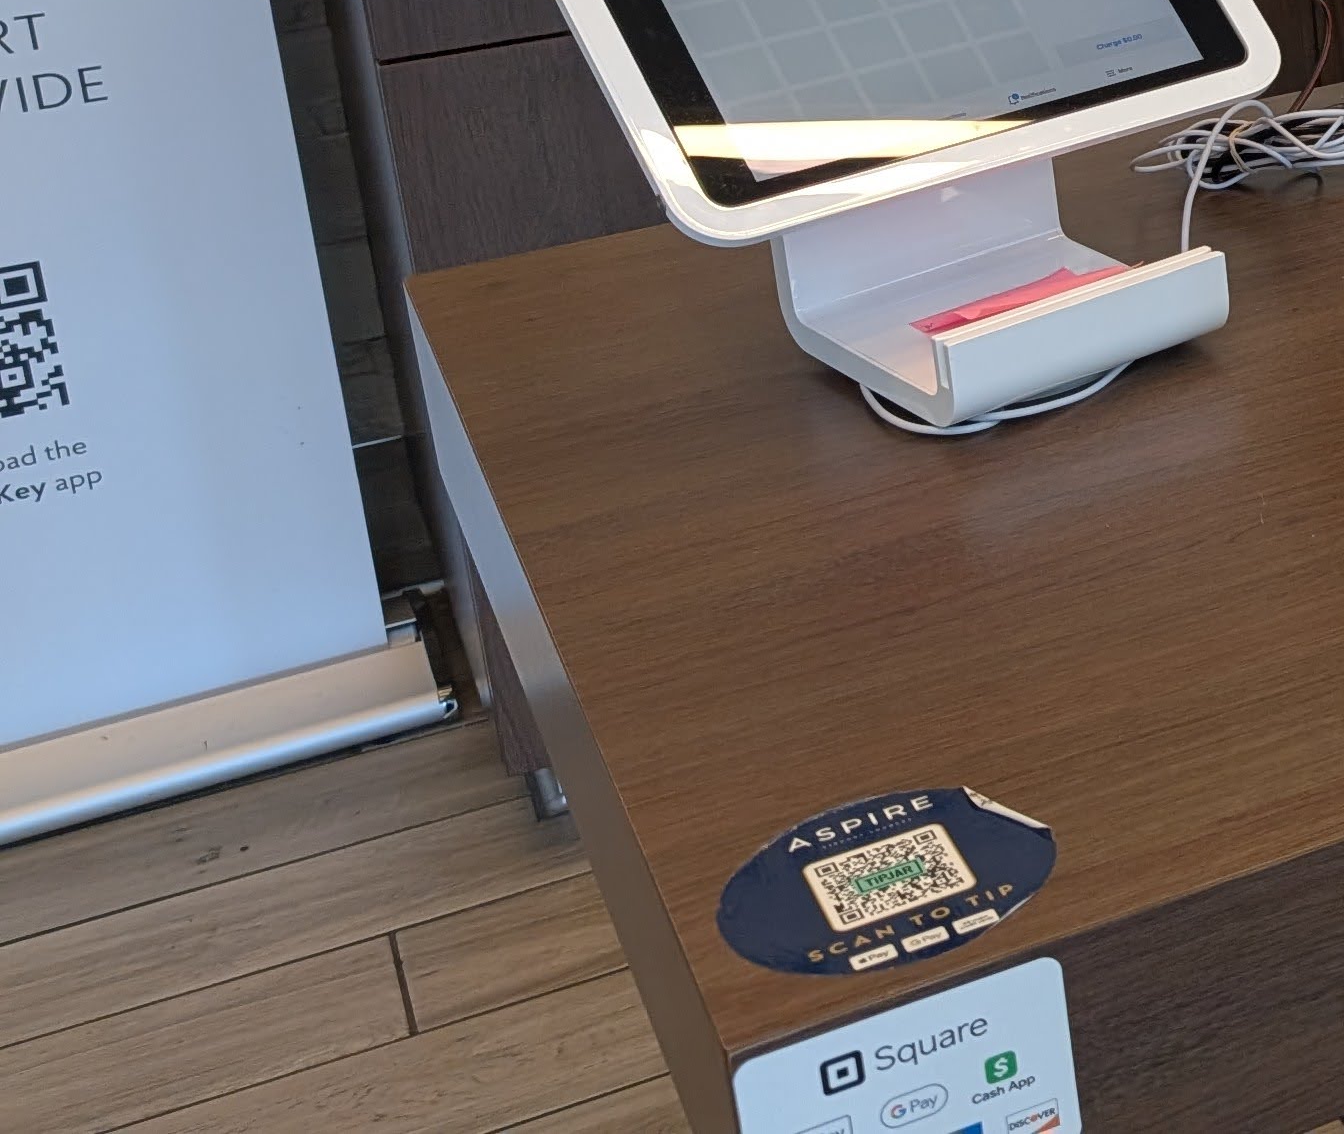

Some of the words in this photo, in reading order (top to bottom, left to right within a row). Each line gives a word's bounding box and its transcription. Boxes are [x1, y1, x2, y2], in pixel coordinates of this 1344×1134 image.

[1096, 39, 1122, 51] Charge
[0, 65, 108, 113] IDE
[44, 439, 87, 461] the
[55, 470, 103, 494] app
[788, 795, 934, 853] ASPIRE
[866, 865, 913, 887] TIPJAR
[807, 924, 895, 963] SCAN
[909, 906, 951, 927] TO
[965, 884, 1013, 907] TIP
[875, 1017, 988, 1072] Square
[971, 1086, 1005, 1105] Cash
[1008, 1074, 1036, 1096] App
[909, 1095, 939, 1114] Pay
